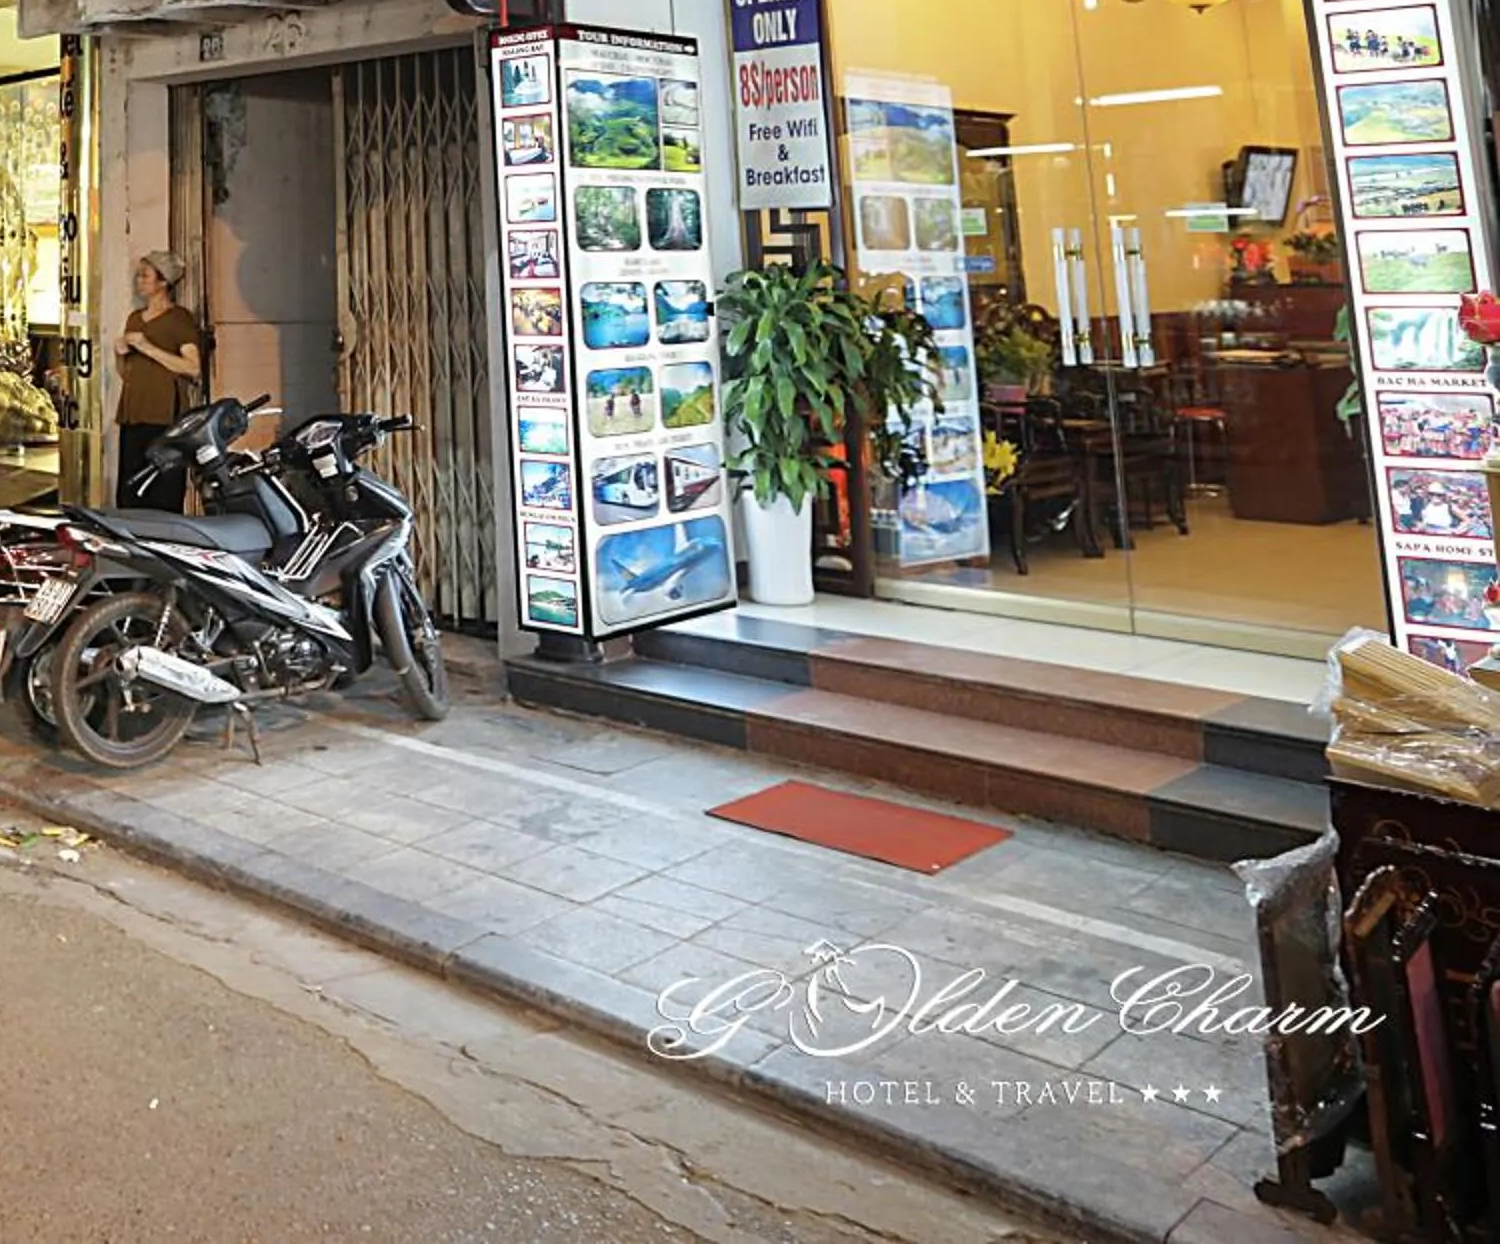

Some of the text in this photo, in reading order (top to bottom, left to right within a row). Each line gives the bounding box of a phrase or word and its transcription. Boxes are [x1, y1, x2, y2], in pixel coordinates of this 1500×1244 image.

[752, 8, 797, 45] ONLY
[577, 30, 608, 43] TOUR
[739, 60, 820, 110] 8$/person
[749, 118, 819, 141] Free Wifi
[777, 144, 790, 161] &
[746, 166, 826, 186] Breakfast
[1377, 376, 1487, 388] BAC HA MARKET
[1395, 541, 1431, 553] SAPA
[1436, 544, 1473, 556] HOME
